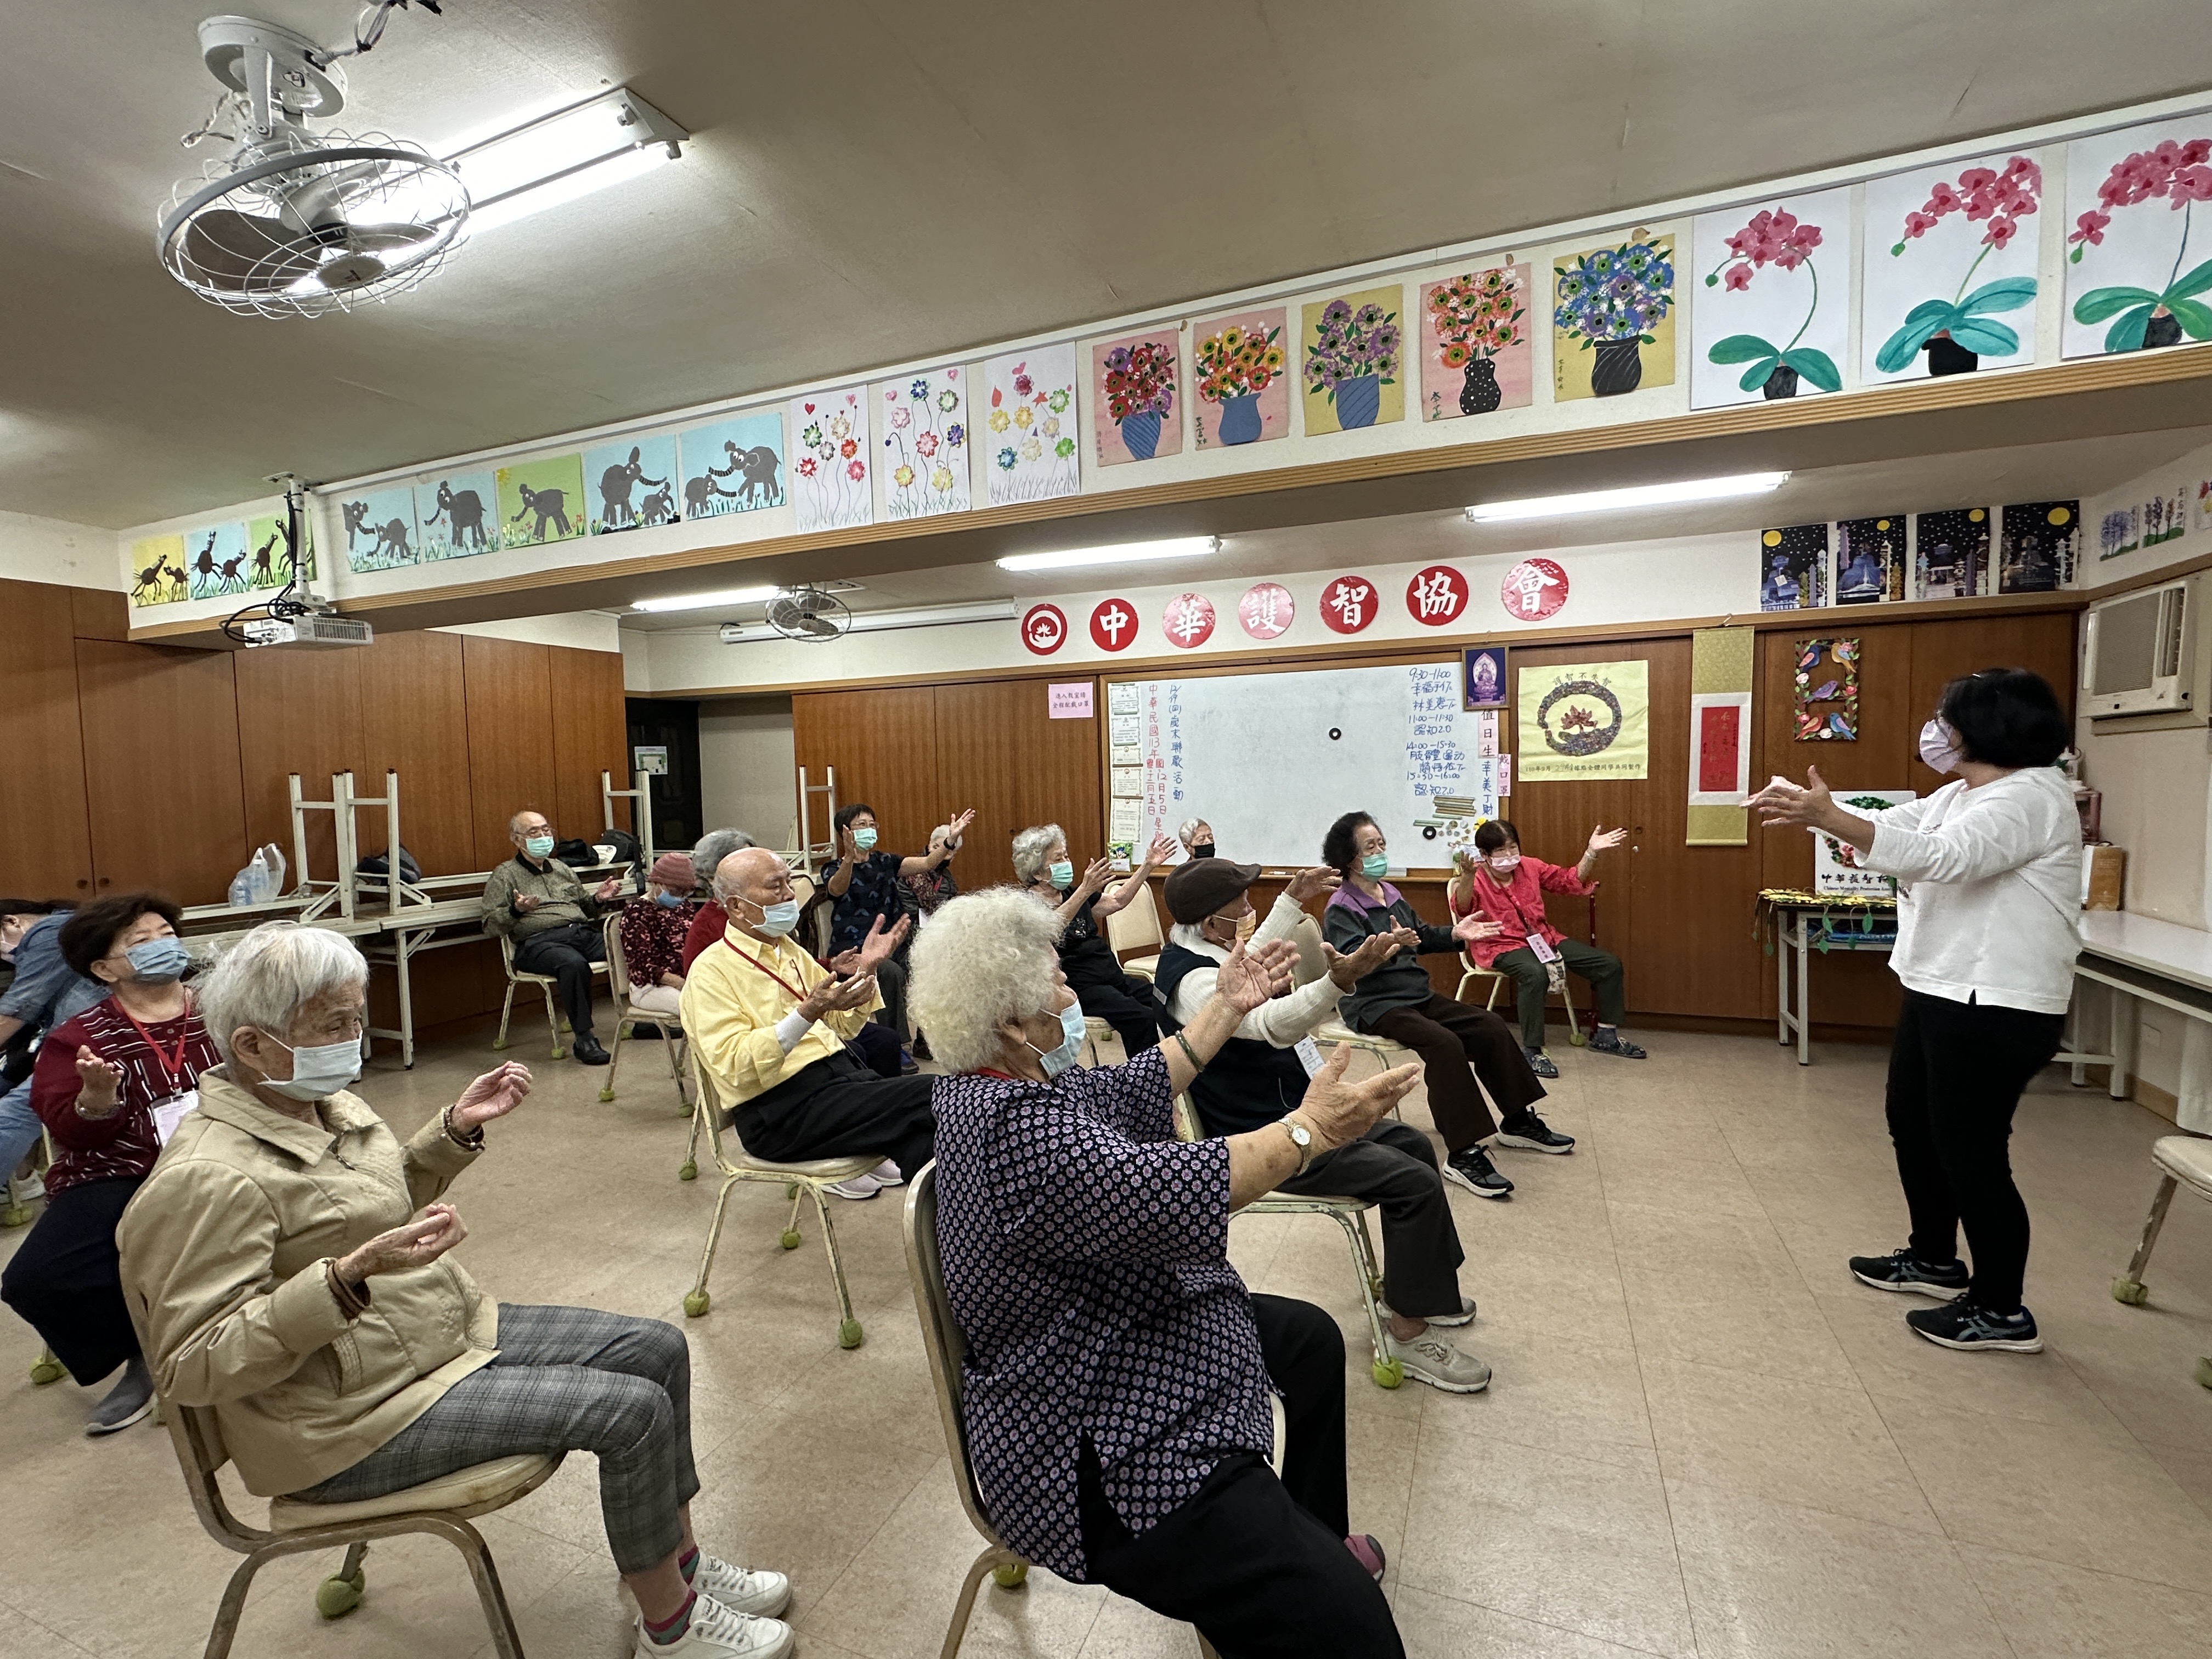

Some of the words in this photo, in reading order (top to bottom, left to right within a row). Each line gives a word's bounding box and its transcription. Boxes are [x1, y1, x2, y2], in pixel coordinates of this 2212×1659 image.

[1100, 568, 1557, 645] 中華護智協會
[1481, 709, 1495, 757] 值日生
